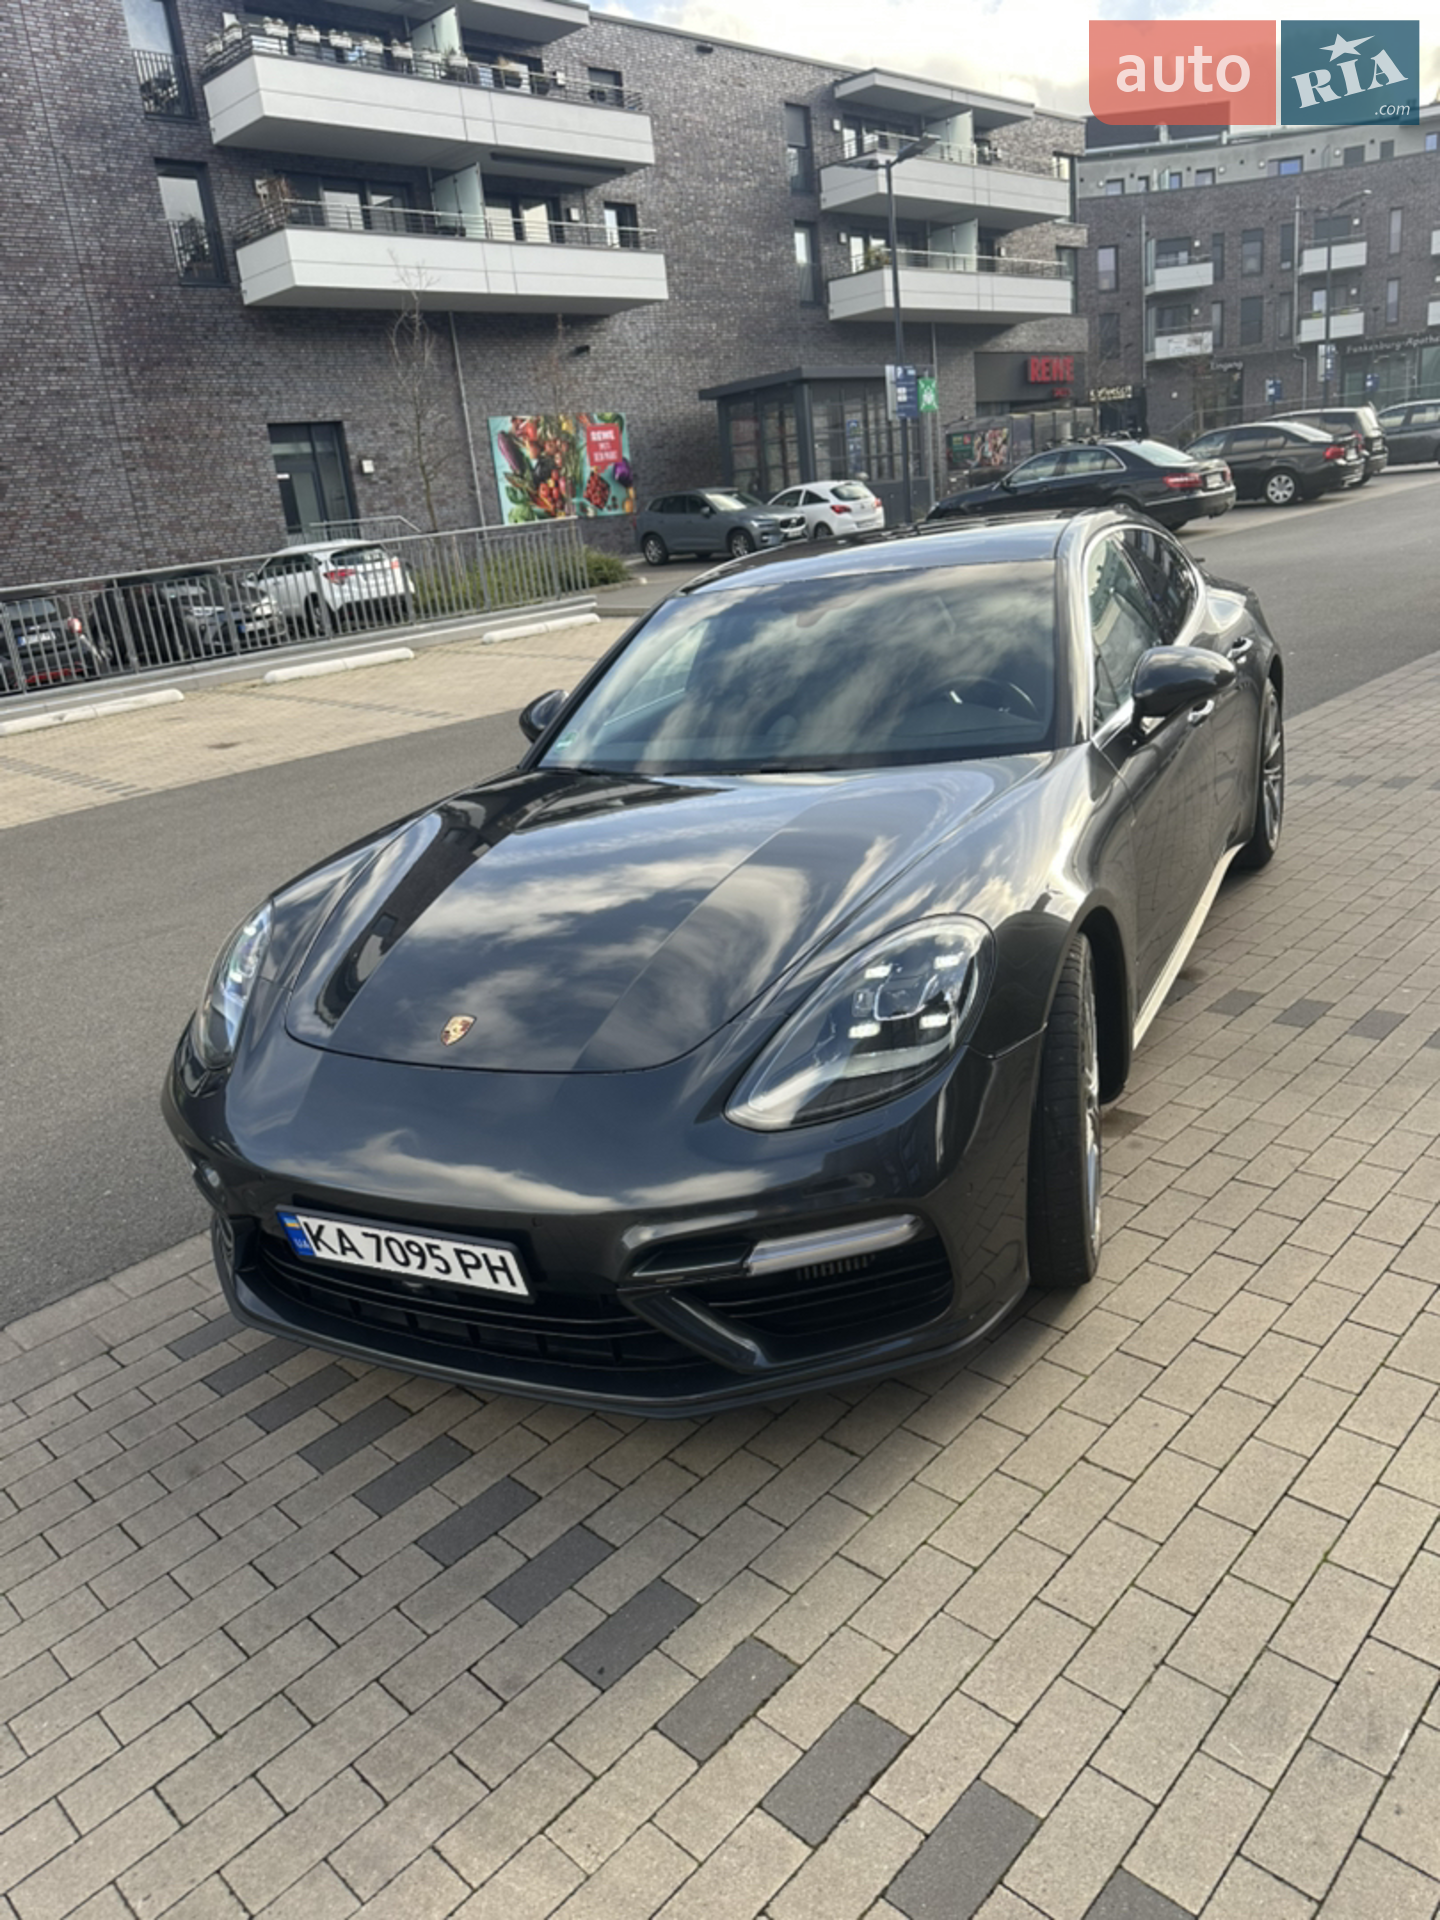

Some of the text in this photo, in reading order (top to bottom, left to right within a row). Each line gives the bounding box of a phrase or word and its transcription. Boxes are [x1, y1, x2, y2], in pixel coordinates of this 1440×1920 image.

[1030, 356, 1074, 384] REWE
[304, 1221, 516, 1287] KA 7095 PH
